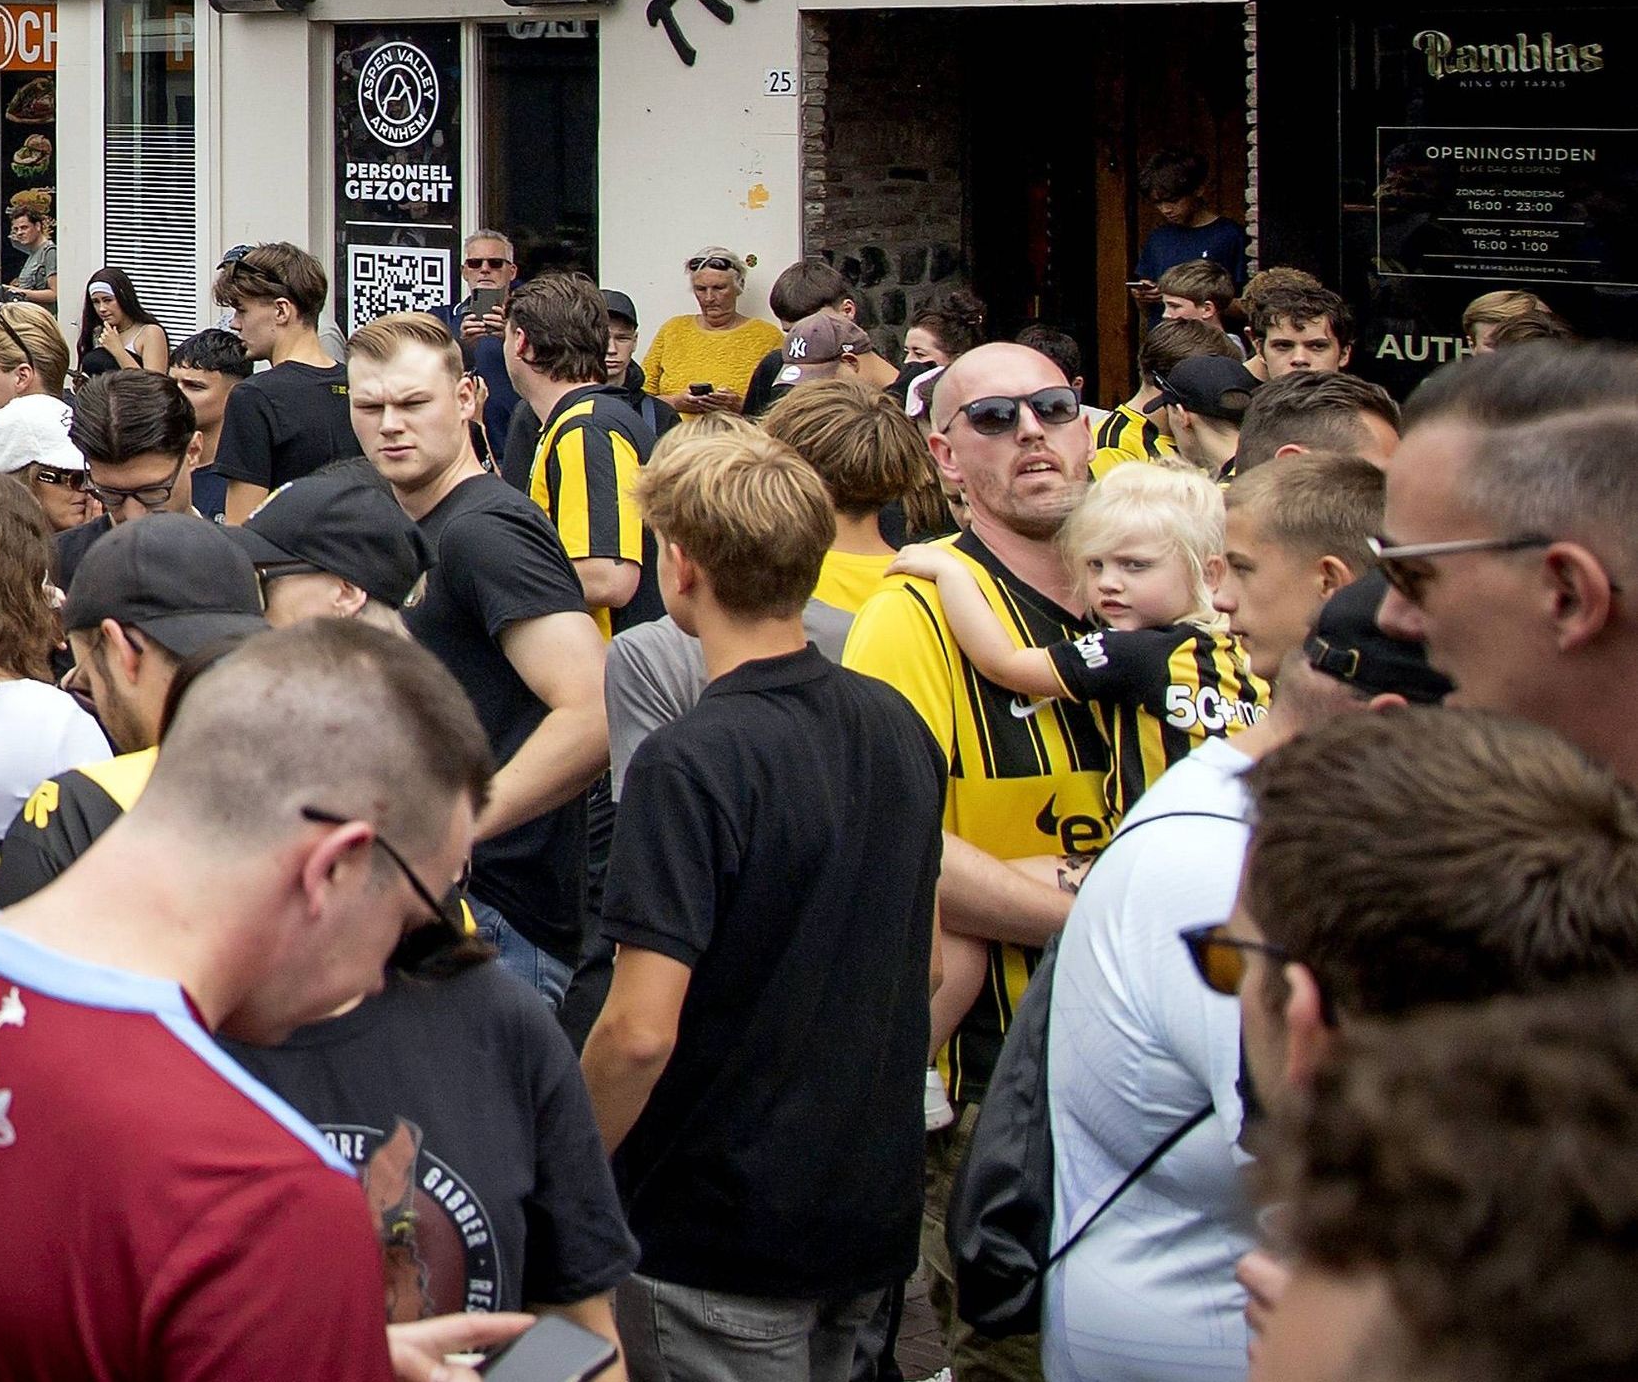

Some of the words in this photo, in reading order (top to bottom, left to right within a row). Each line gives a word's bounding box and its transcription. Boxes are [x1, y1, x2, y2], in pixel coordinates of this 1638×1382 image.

[1412, 29, 1605, 80] Ramblas
[363, 50, 393, 101] ASPEN
[396, 48, 434, 101] VALLEY
[769, 71, 791, 92] 25
[369, 112, 428, 141] ARNHEM
[1425, 146, 1597, 162] OPENINGSTIJDEN
[345, 162, 453, 182] PERSONEEL
[344, 179, 454, 203] GEZOCHT
[1455, 188, 1496, 198] ZONDAG
[1503, 190, 1565, 199] DONDERDAG
[1467, 200, 1502, 211] 16:00
[1516, 202, 1553, 213] 23:00
[1509, 229, 1560, 238] ZATERDAG
[1472, 239, 1508, 251] 16:00
[1522, 241, 1549, 252] 1:00
[423, 1167, 488, 1249] GABBER
